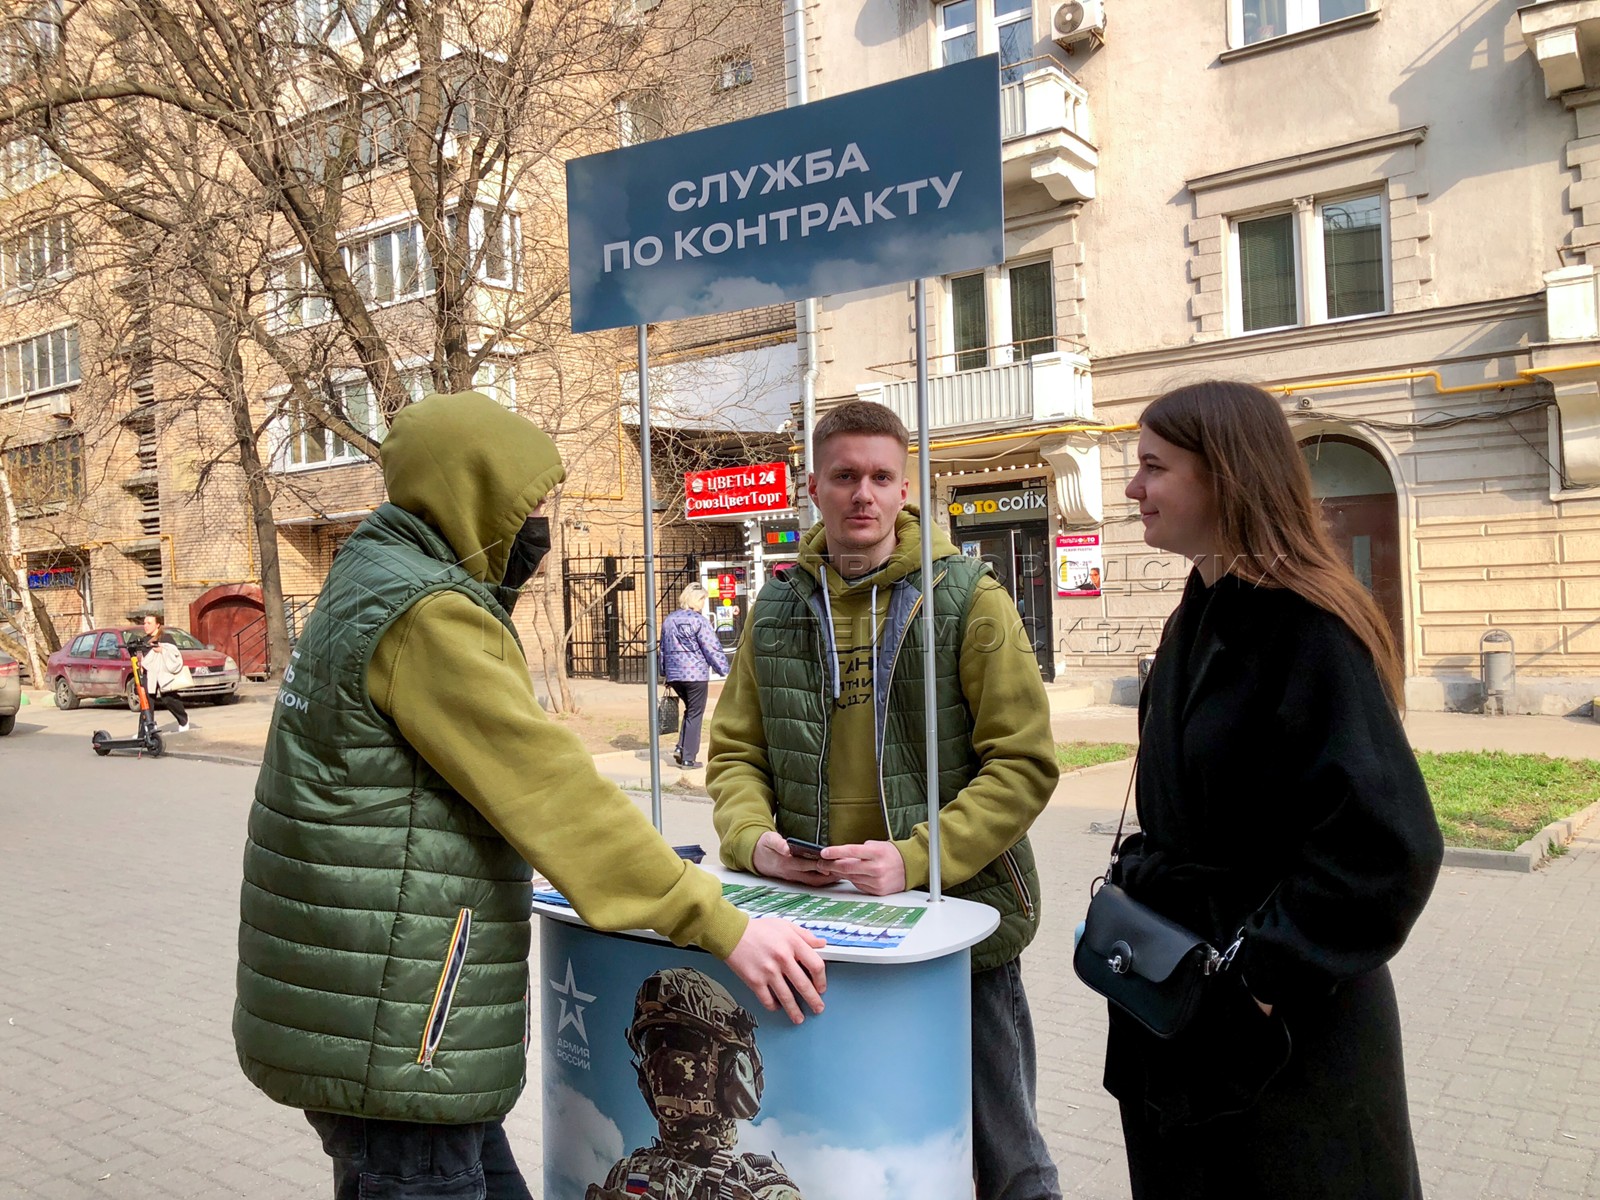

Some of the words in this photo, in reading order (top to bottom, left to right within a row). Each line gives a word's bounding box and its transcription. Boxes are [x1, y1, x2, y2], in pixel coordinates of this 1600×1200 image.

[668, 142, 870, 212] СЛУЖБА
[603, 236, 664, 274] ПО
[674, 171, 963, 261] КОНТРАКТУ
[707, 472, 756, 492] ЦВЕТЫ
[758, 470, 776, 485] 24
[686, 491, 782, 510] СоюзЦветТорг
[557, 1037, 590, 1059] АРМИЯ
[557, 1048, 591, 1071] РОССИИ
